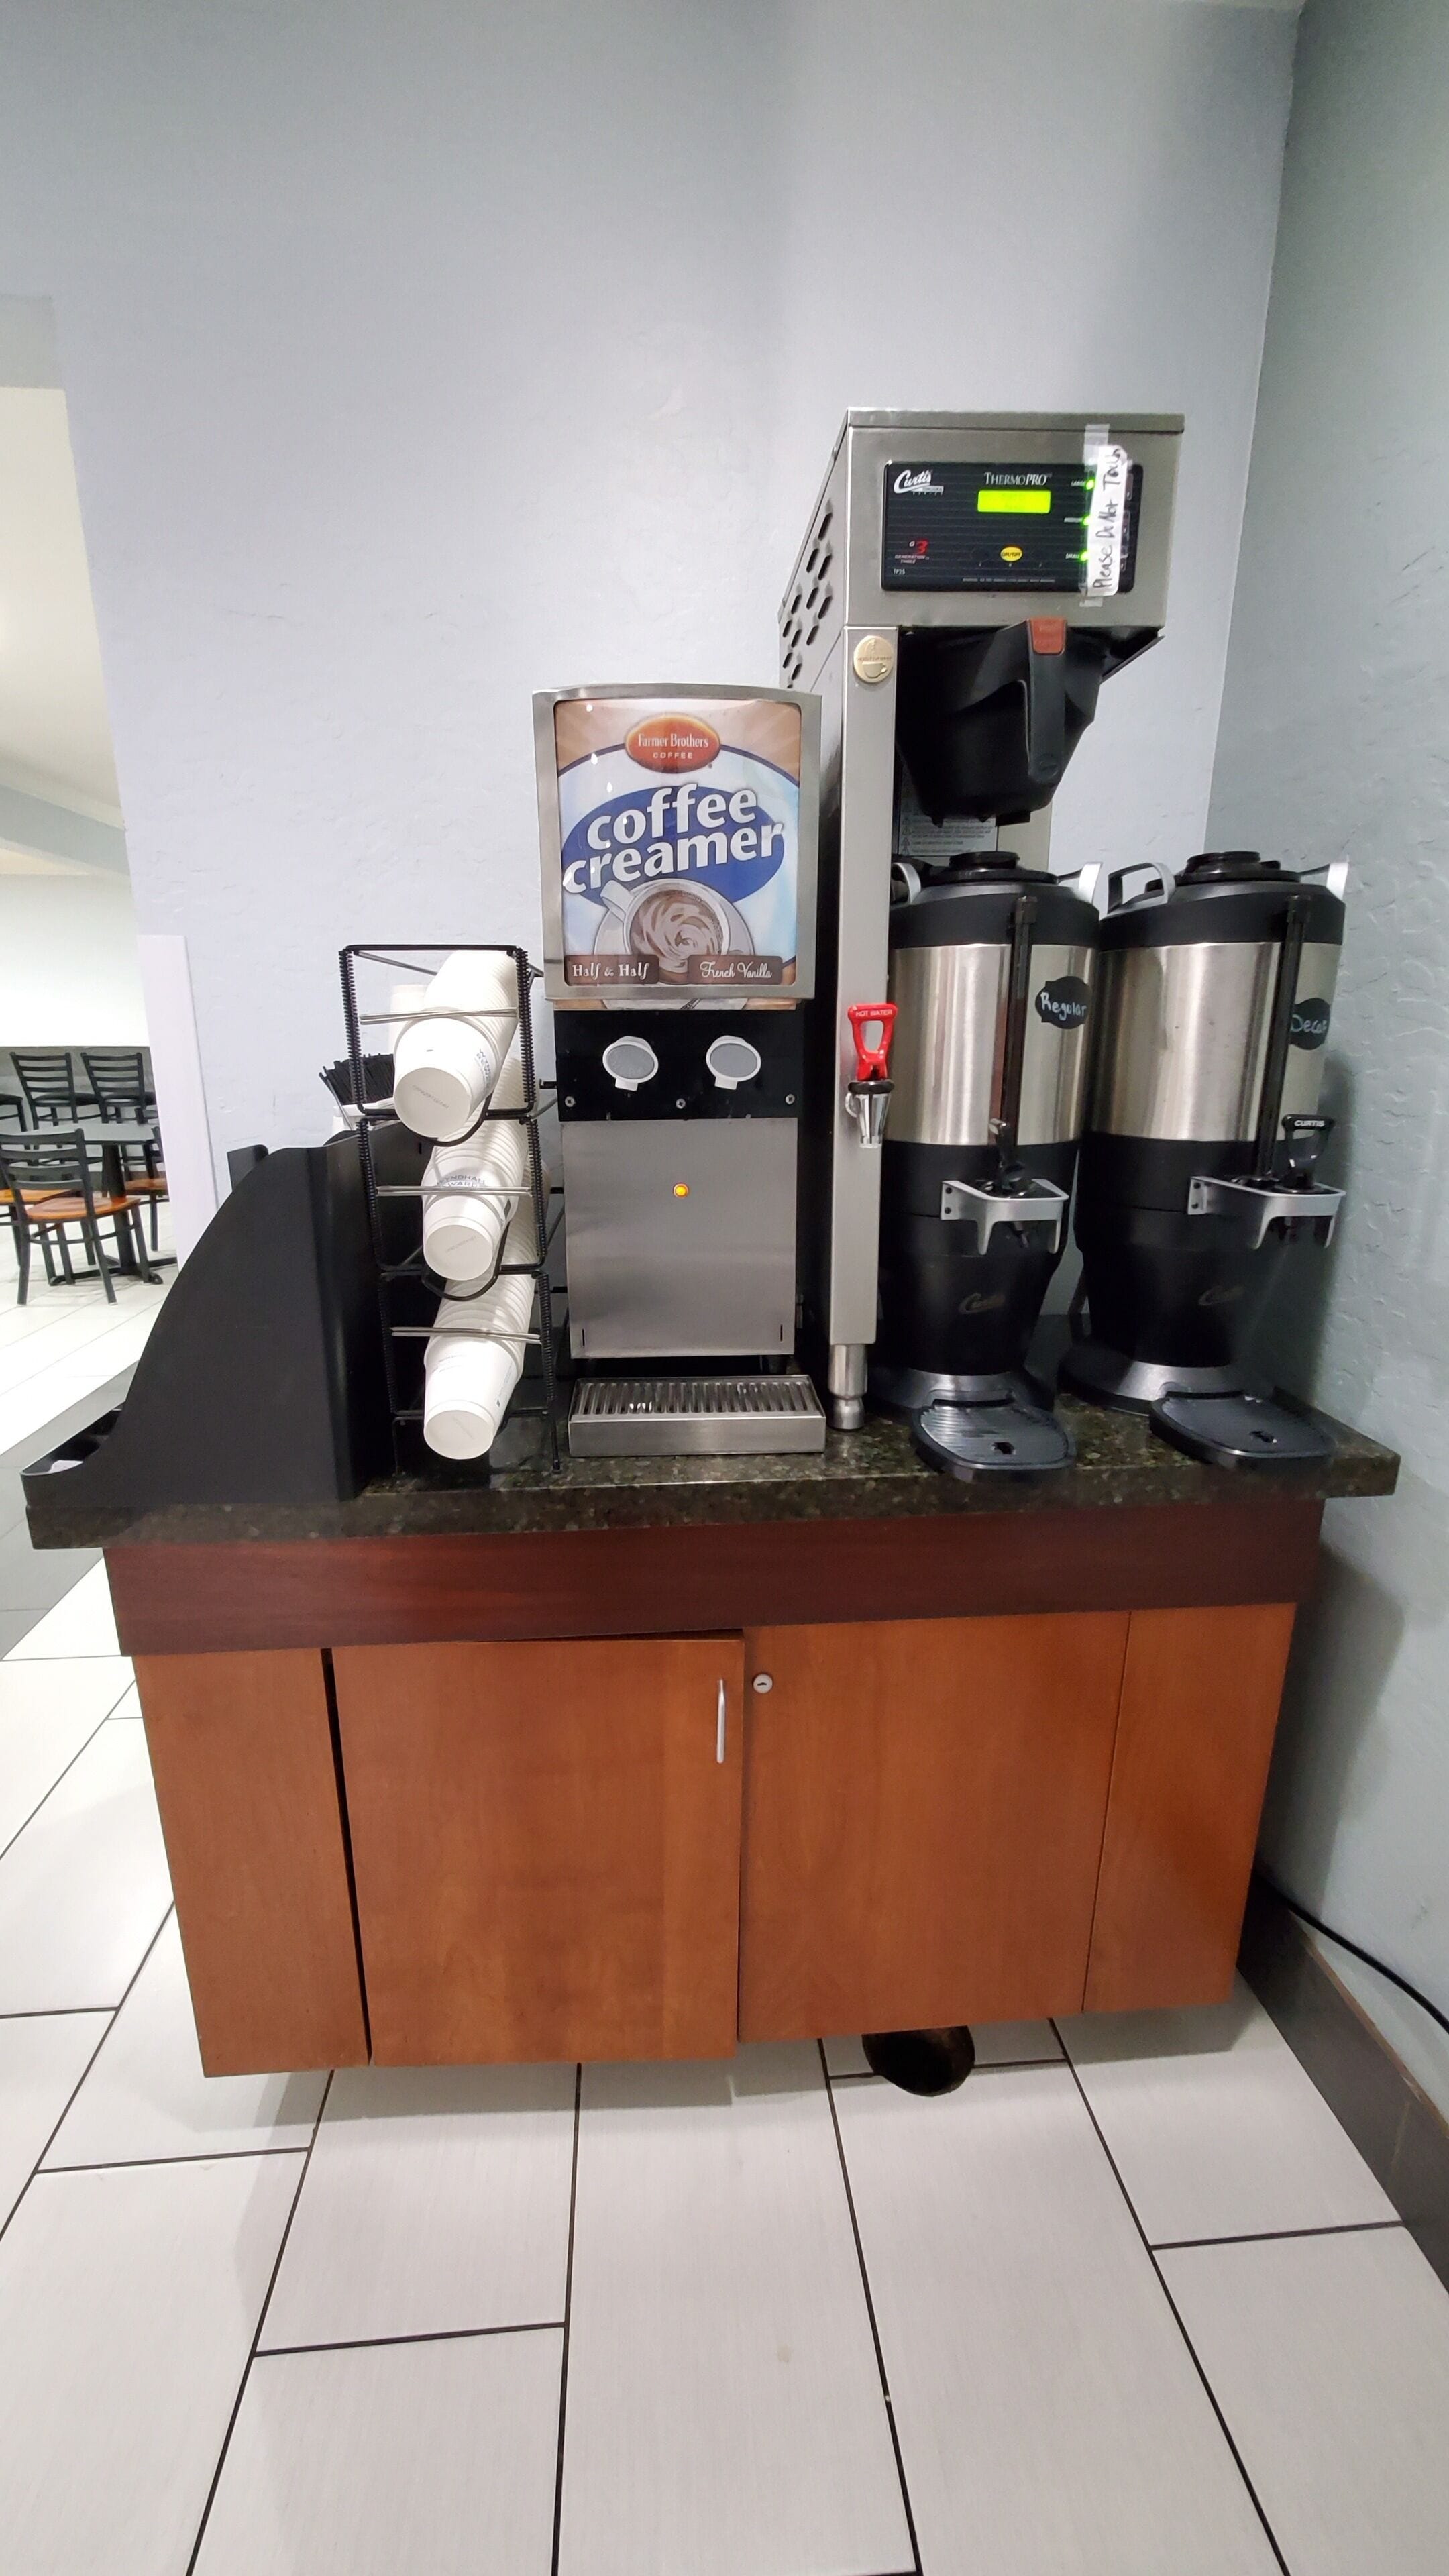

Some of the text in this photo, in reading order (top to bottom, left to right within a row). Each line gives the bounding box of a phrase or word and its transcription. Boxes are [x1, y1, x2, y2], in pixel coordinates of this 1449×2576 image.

[894, 470, 932, 494] Curtis
[1098, 499, 1119, 523] Not
[1093, 545, 1113, 588] Please
[638, 733, 710, 748] Farmer Brothers
[586, 783, 757, 851] coffee
[562, 822, 783, 894] creamer
[573, 962, 650, 980] Half & Half
[700, 961, 773, 979] French Vanilla
[1040, 991, 1087, 1021] Regular
[1293, 1120, 1326, 1128] CURTIS
